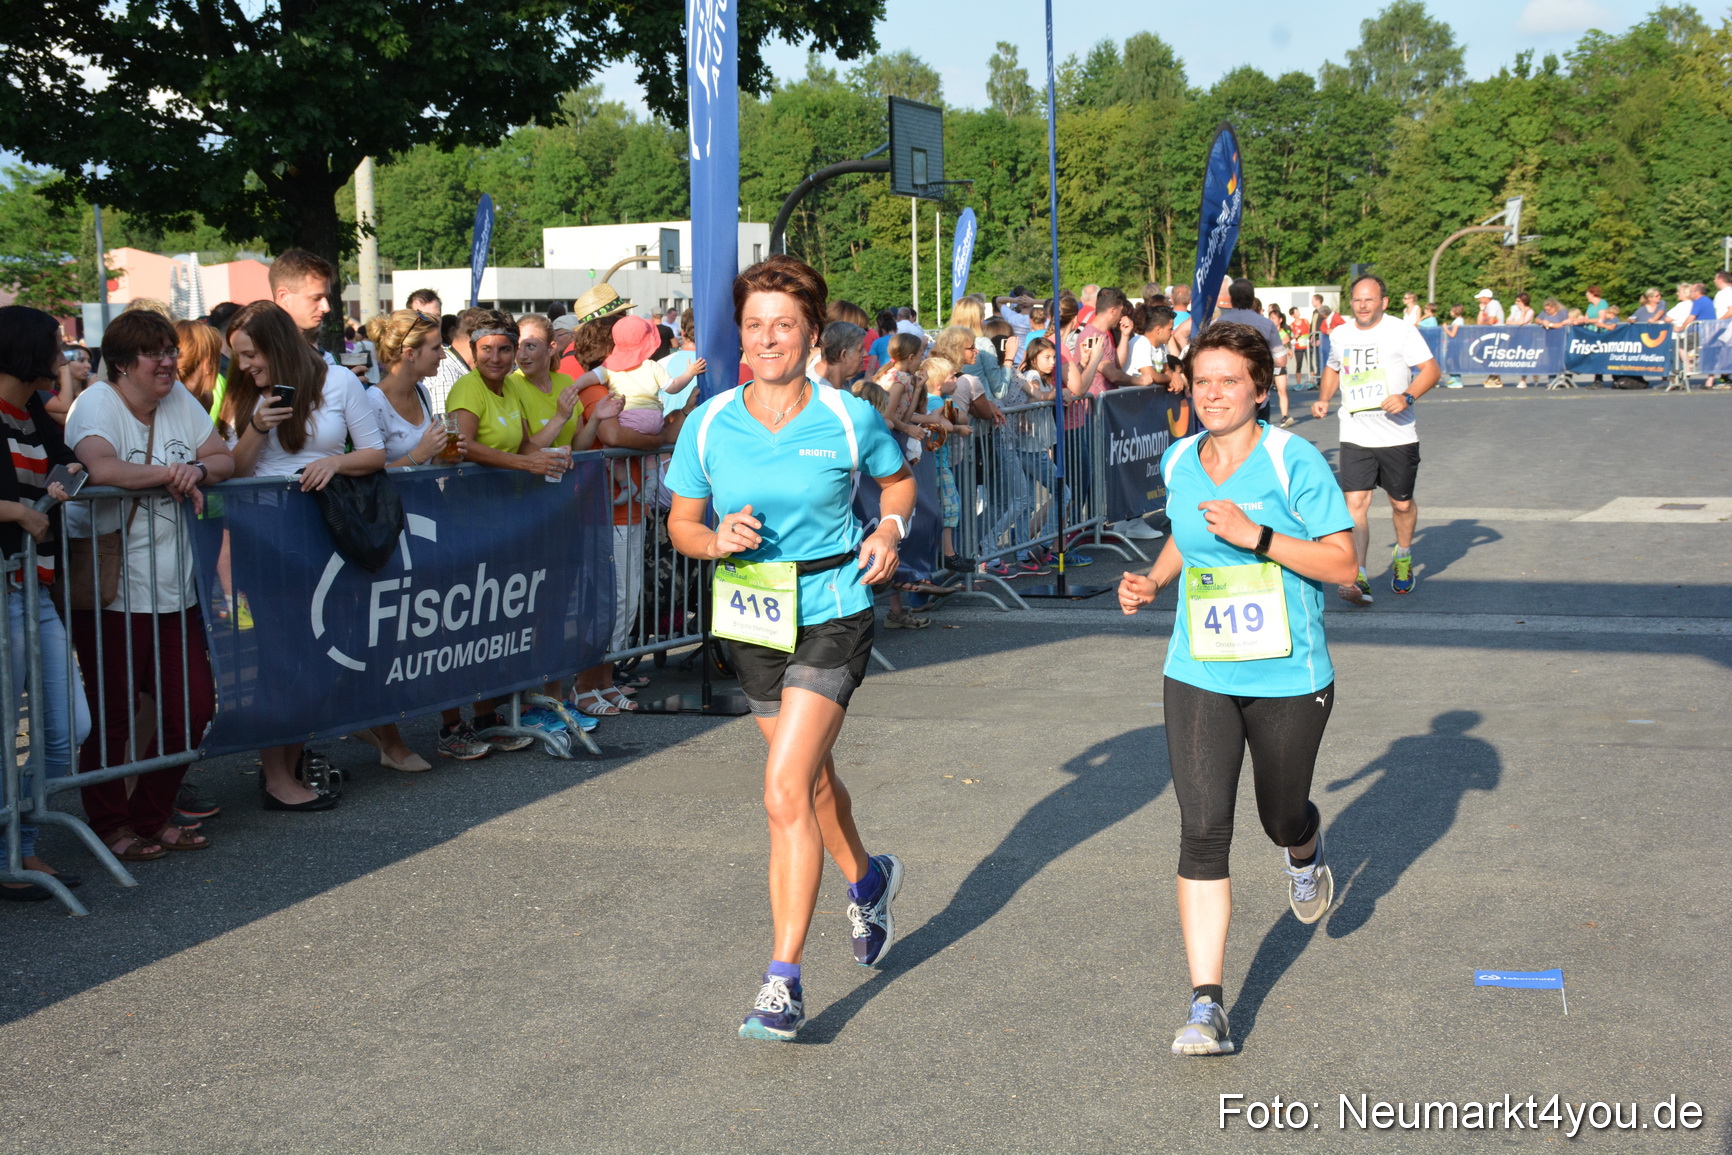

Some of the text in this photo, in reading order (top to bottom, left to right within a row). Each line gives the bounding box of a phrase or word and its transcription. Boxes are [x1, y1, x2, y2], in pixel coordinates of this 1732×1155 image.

[1483, 345, 1544, 360] Fischer
[1569, 339, 1643, 355] Frischmann
[1628, 354, 1640, 362] und
[1640, 354, 1666, 363] Medien
[1350, 384, 1384, 400] 1172
[799, 449, 837, 459] BRIGITTE
[368, 562, 546, 648] Fischer
[730, 590, 781, 622] 418
[1204, 603, 1264, 634] 419
[385, 627, 533, 685] AUTOMOBILE
